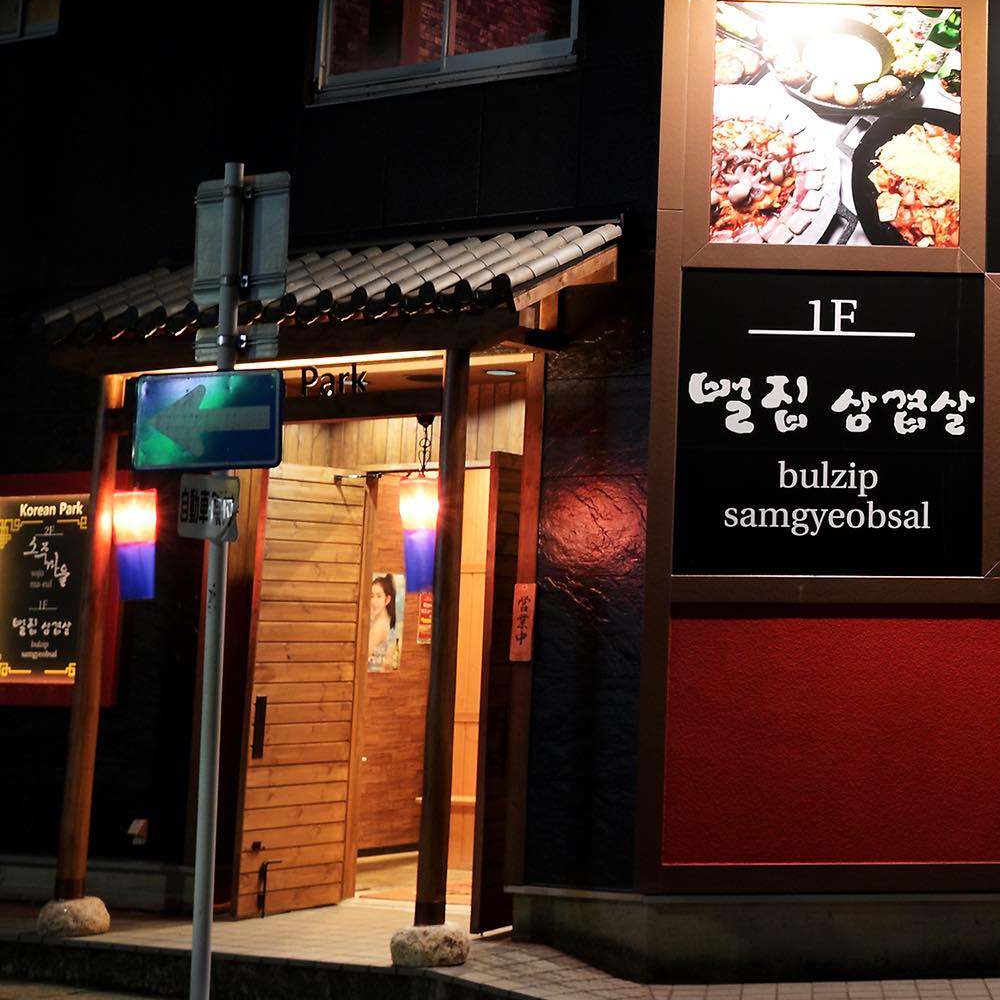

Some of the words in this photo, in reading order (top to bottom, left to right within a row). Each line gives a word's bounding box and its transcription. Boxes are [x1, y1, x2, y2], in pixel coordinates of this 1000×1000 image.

[808, 299, 858, 333] 1F
[301, 363, 368, 399] Park
[778, 460, 879, 497] bulzip
[20, 503, 57, 517] Korean
[59, 501, 84, 516] Park
[724, 501, 931, 536] samgyeobsal
